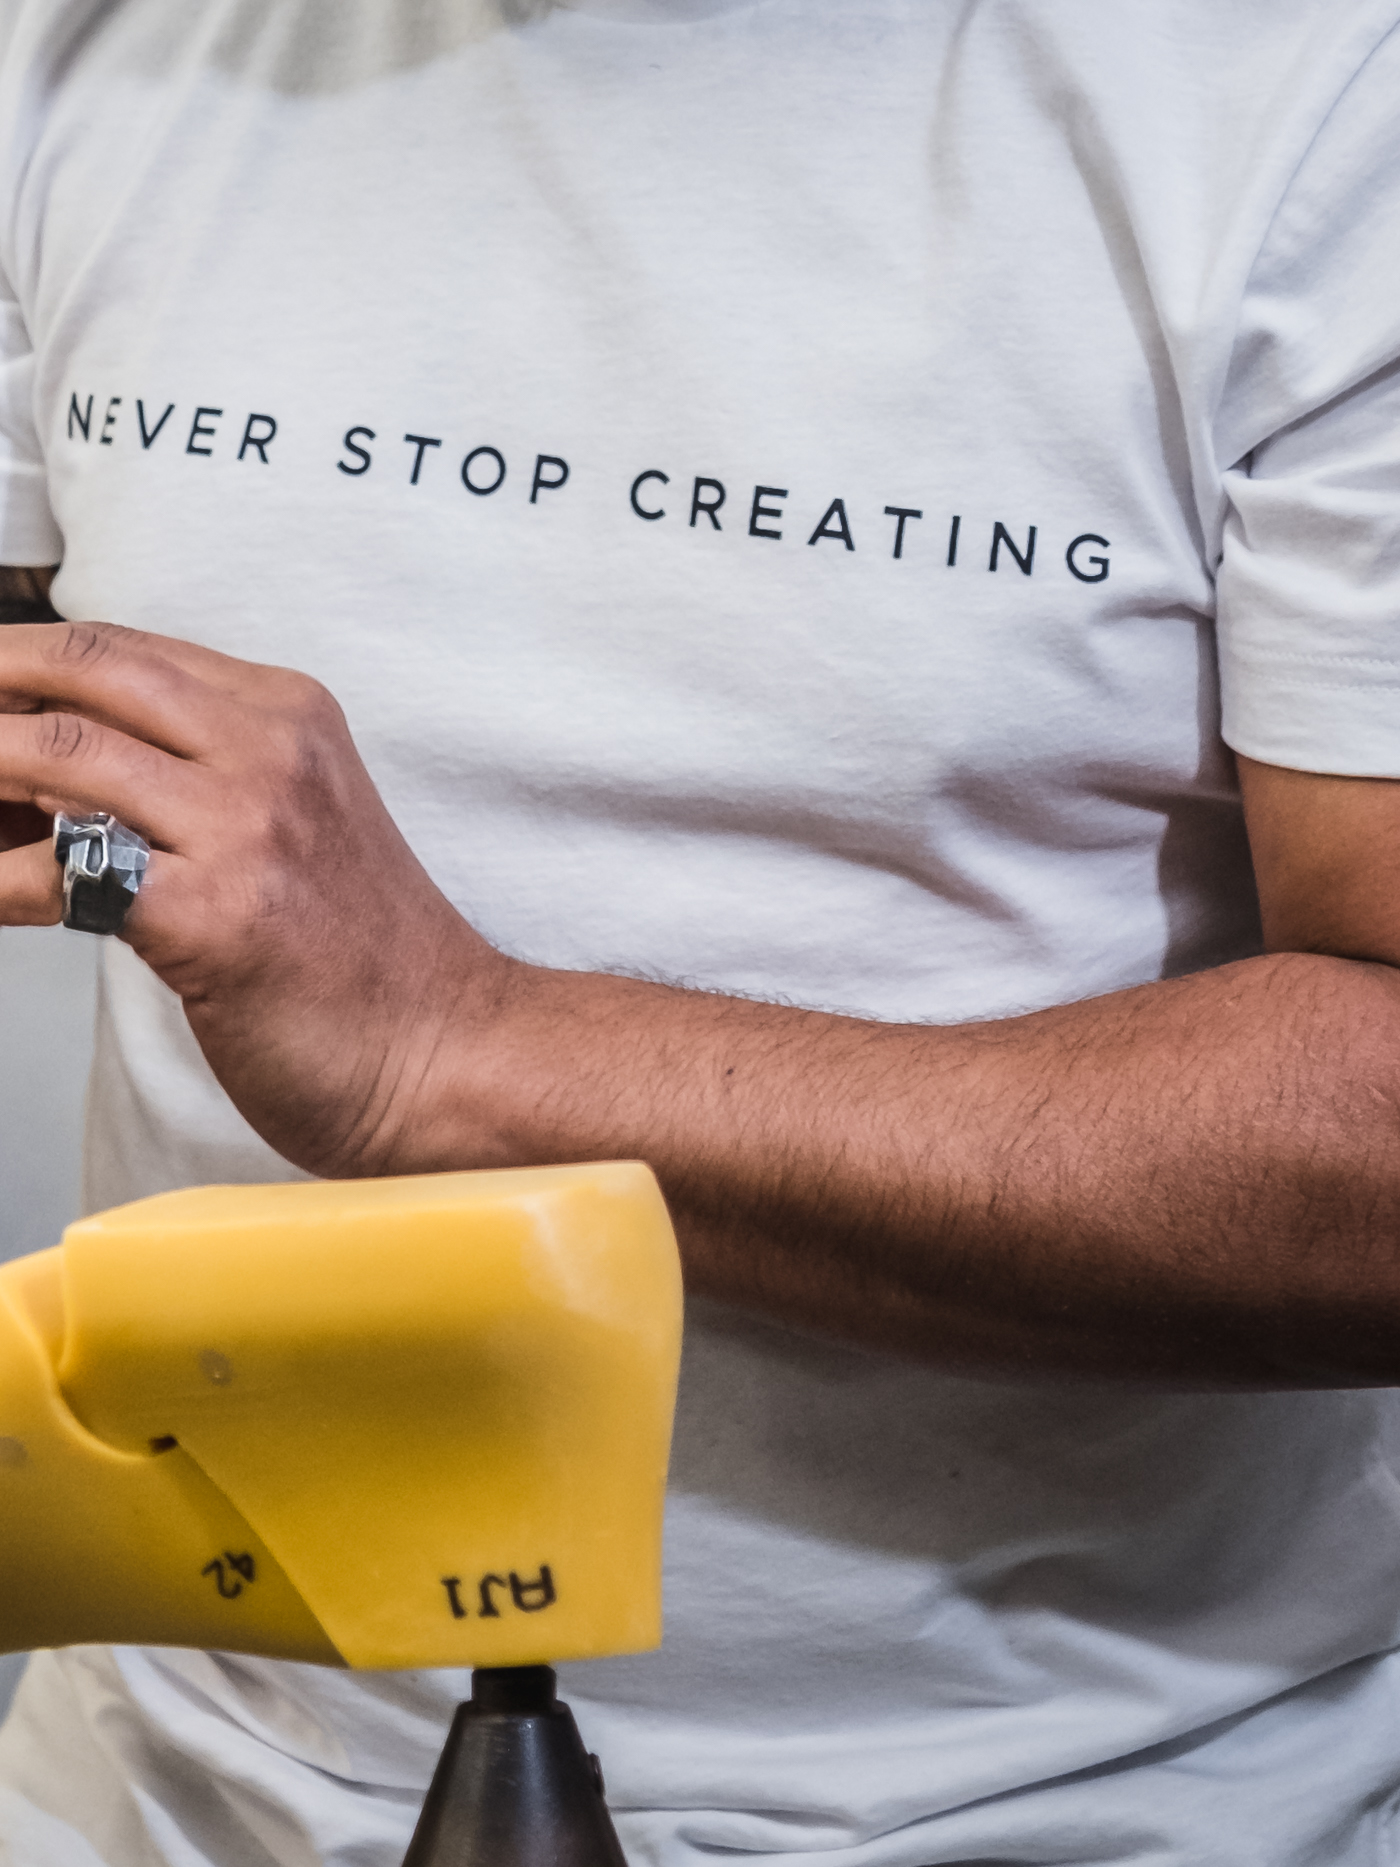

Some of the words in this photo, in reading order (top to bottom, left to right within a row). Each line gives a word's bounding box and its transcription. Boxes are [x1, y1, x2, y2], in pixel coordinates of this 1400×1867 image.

[66, 391, 279, 465] NEVER
[336, 425, 571, 505] STOP
[628, 468, 1112, 584] CREATING
[200, 1549, 258, 1602] 42
[438, 1564, 559, 1621] AJ1
